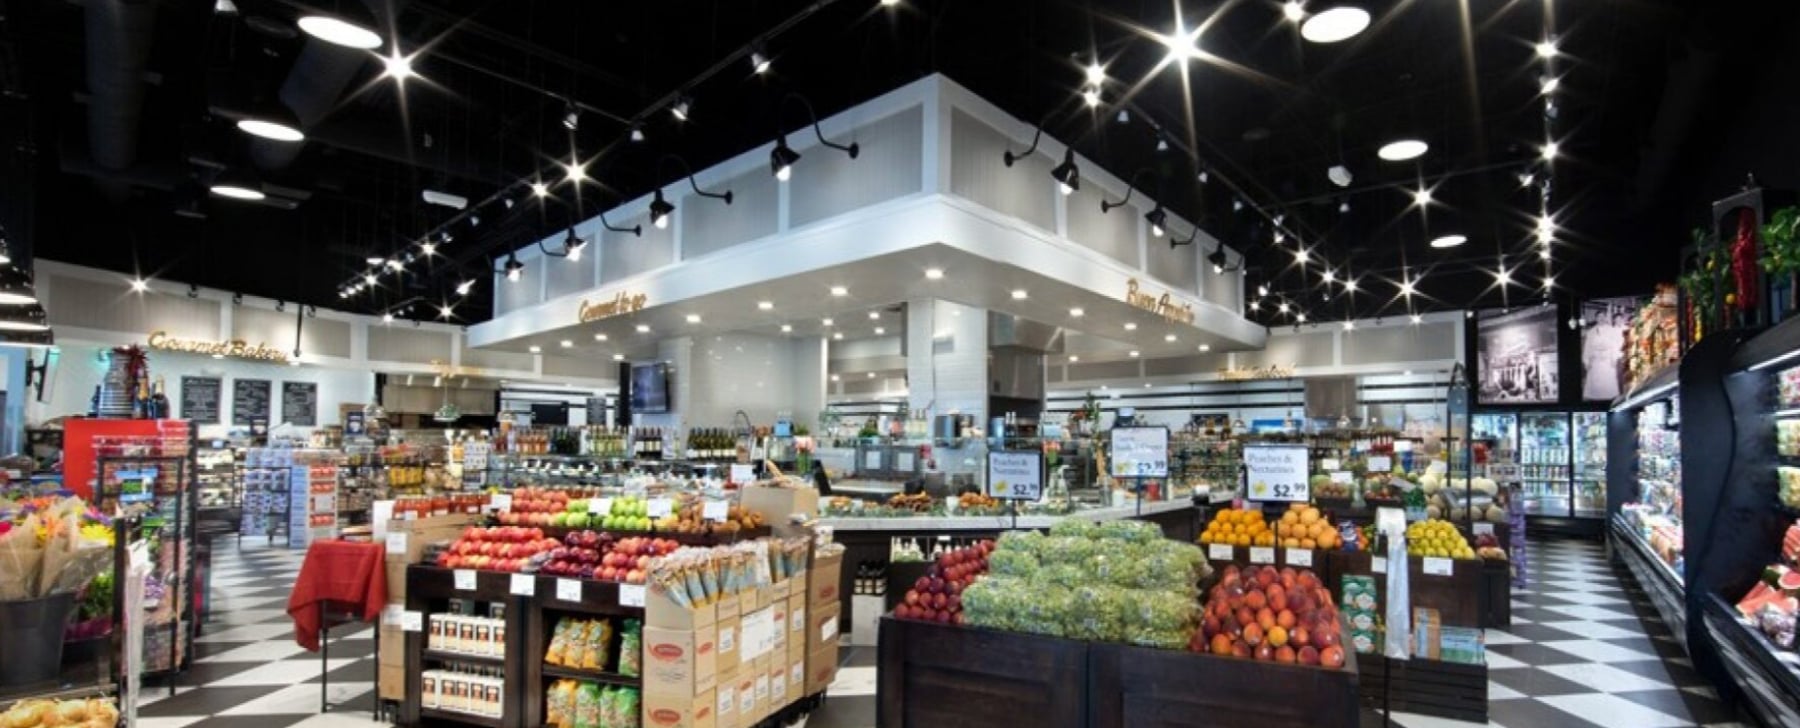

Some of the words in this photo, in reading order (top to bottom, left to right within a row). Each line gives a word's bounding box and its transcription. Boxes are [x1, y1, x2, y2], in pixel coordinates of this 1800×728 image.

[1127, 278, 1156, 312] Buon
[148, 331, 227, 354] Gourmet
[228, 340, 289, 365] Bakery
[1247, 453, 1282, 463] Peaches
[1273, 482, 1307, 498] $2.99
